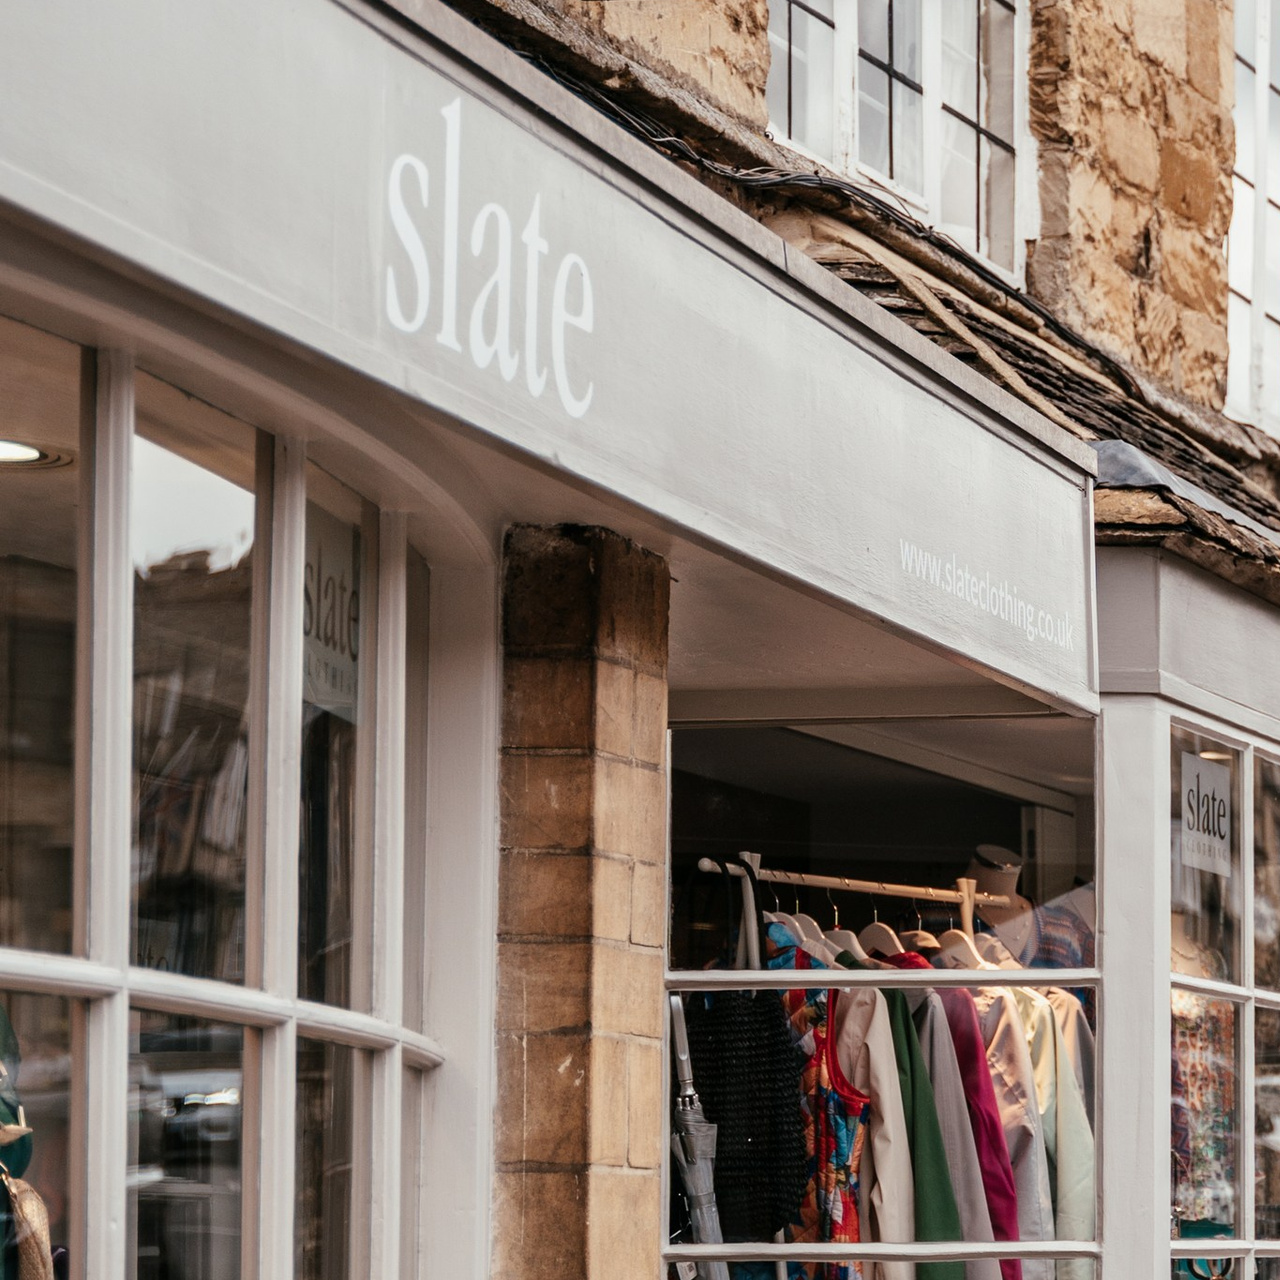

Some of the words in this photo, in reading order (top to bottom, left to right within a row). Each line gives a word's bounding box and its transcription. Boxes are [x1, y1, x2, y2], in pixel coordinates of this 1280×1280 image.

[385, 96, 594, 419] slate
[302, 542, 360, 663] slate
[899, 538, 1074, 651] www.slateclothing.co.uk
[1186, 771, 1228, 841] slate
